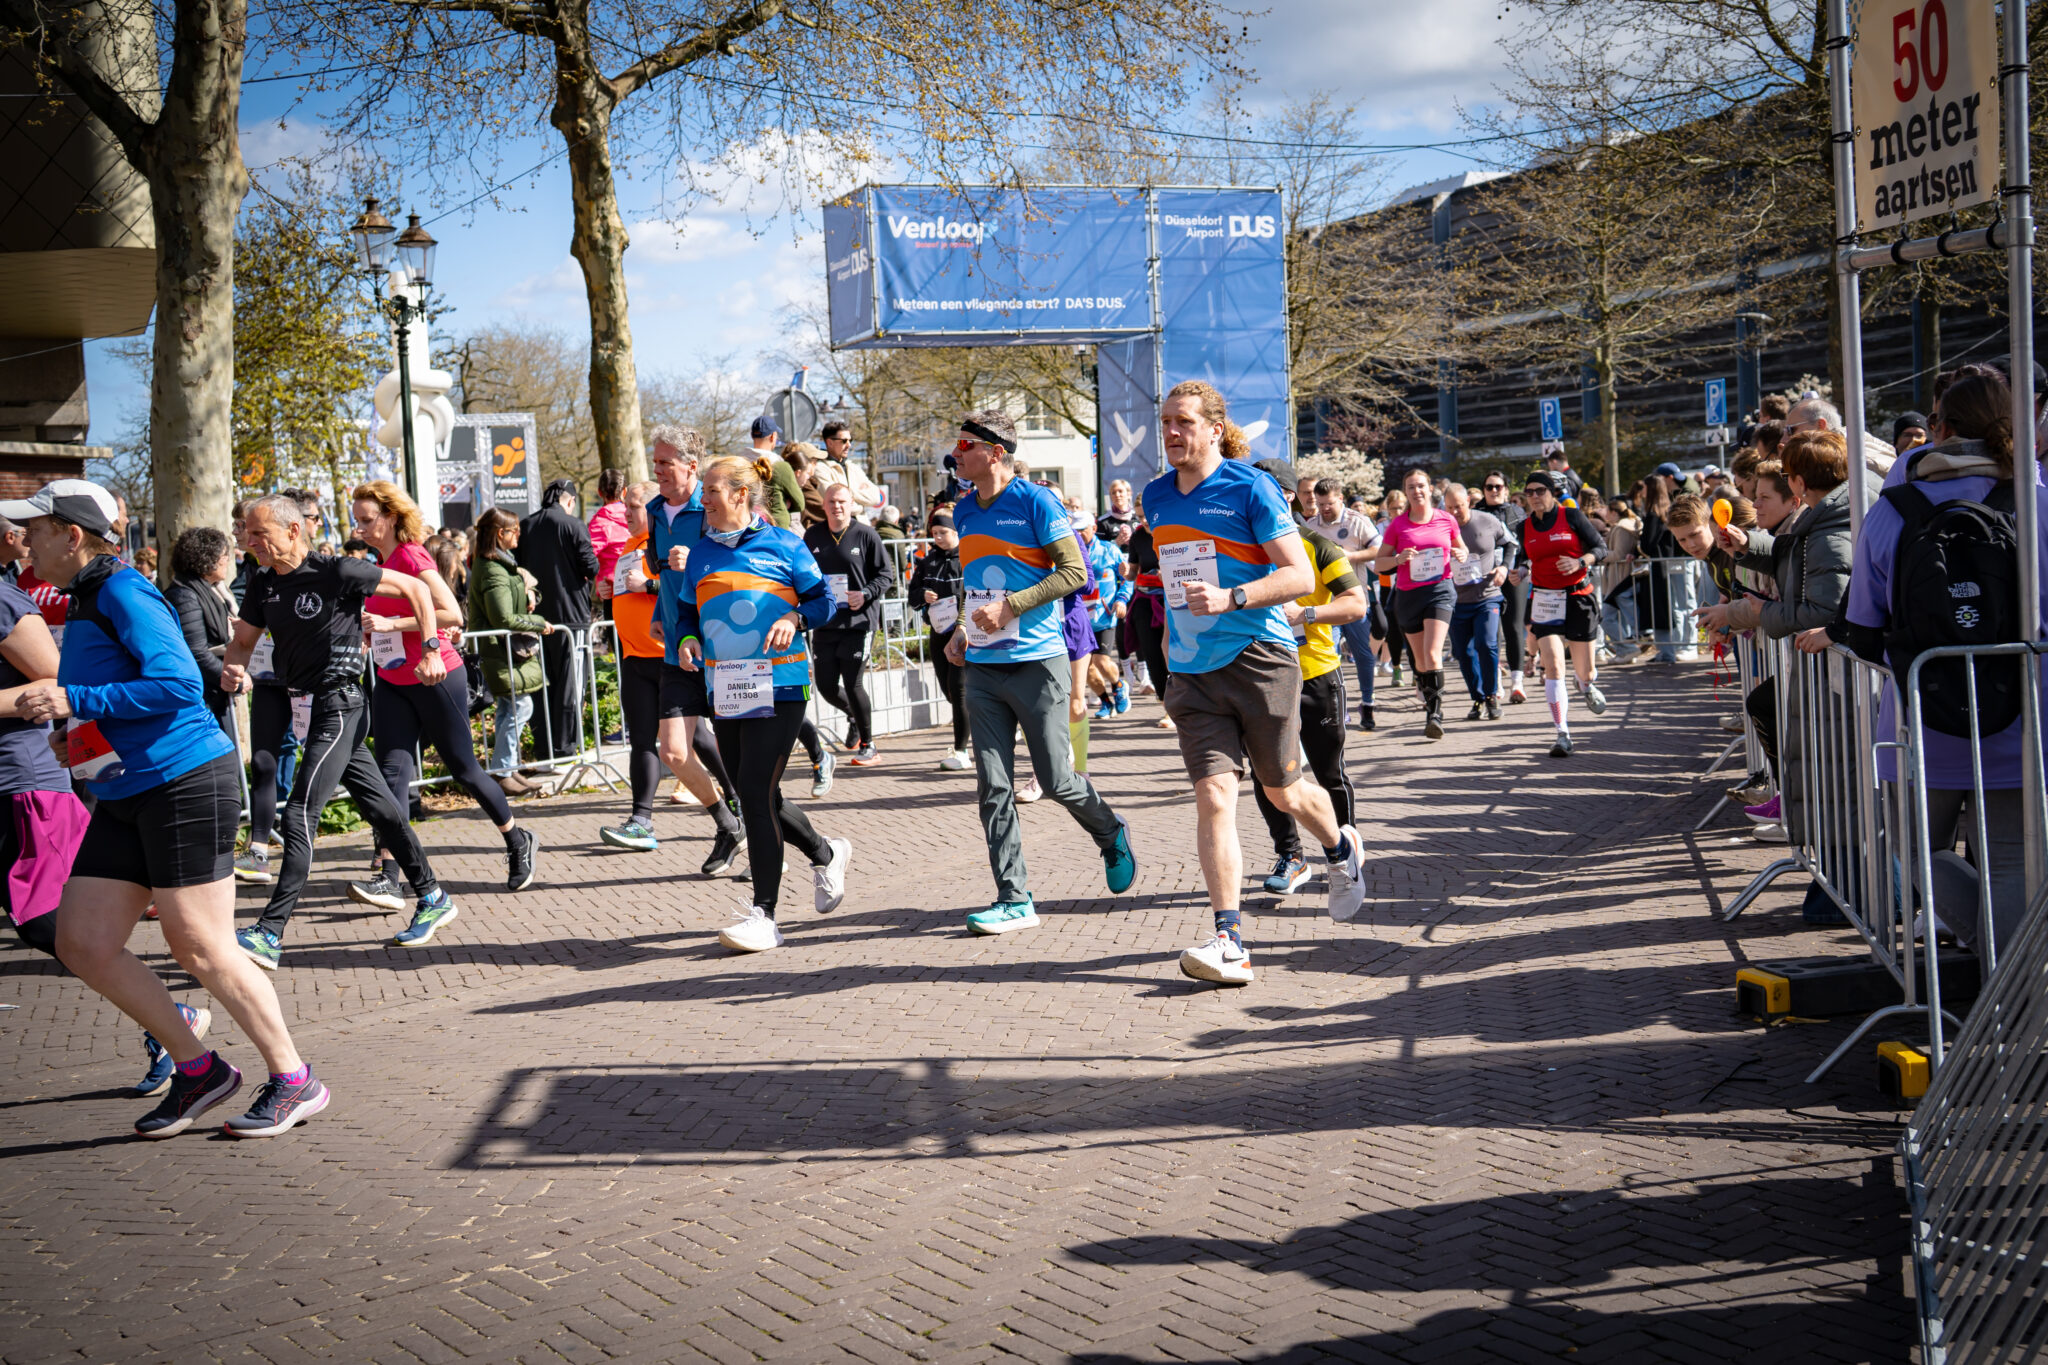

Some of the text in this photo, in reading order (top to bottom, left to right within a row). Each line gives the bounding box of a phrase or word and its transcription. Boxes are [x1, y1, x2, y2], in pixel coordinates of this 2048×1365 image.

[1893, 0, 1949, 103] 50
[1870, 92, 1980, 170] meter
[1875, 159, 1978, 219] aartsen
[1165, 214, 1223, 226] Düsseldorf
[1228, 215, 1276, 238] DUS
[887, 215, 998, 245] Venloop
[1186, 227, 1224, 240] Airport
[851, 247, 869, 276] DUS
[893, 297, 1126, 313] Meteen een vliegende start? DA'S DUS.
[1710, 384, 1720, 406] P
[1543, 402, 1554, 423] P
[1199, 507, 1236, 518] Venloop
[996, 519, 1027, 527] Venloop
[1161, 545, 1190, 556] Venloop
[749, 557, 783, 567] Venloop
[1173, 568, 1198, 578] DENNIS
[717, 662, 747, 671] Venloop
[727, 682, 757, 691] DANIELA
[733, 691, 759, 700] 11308
